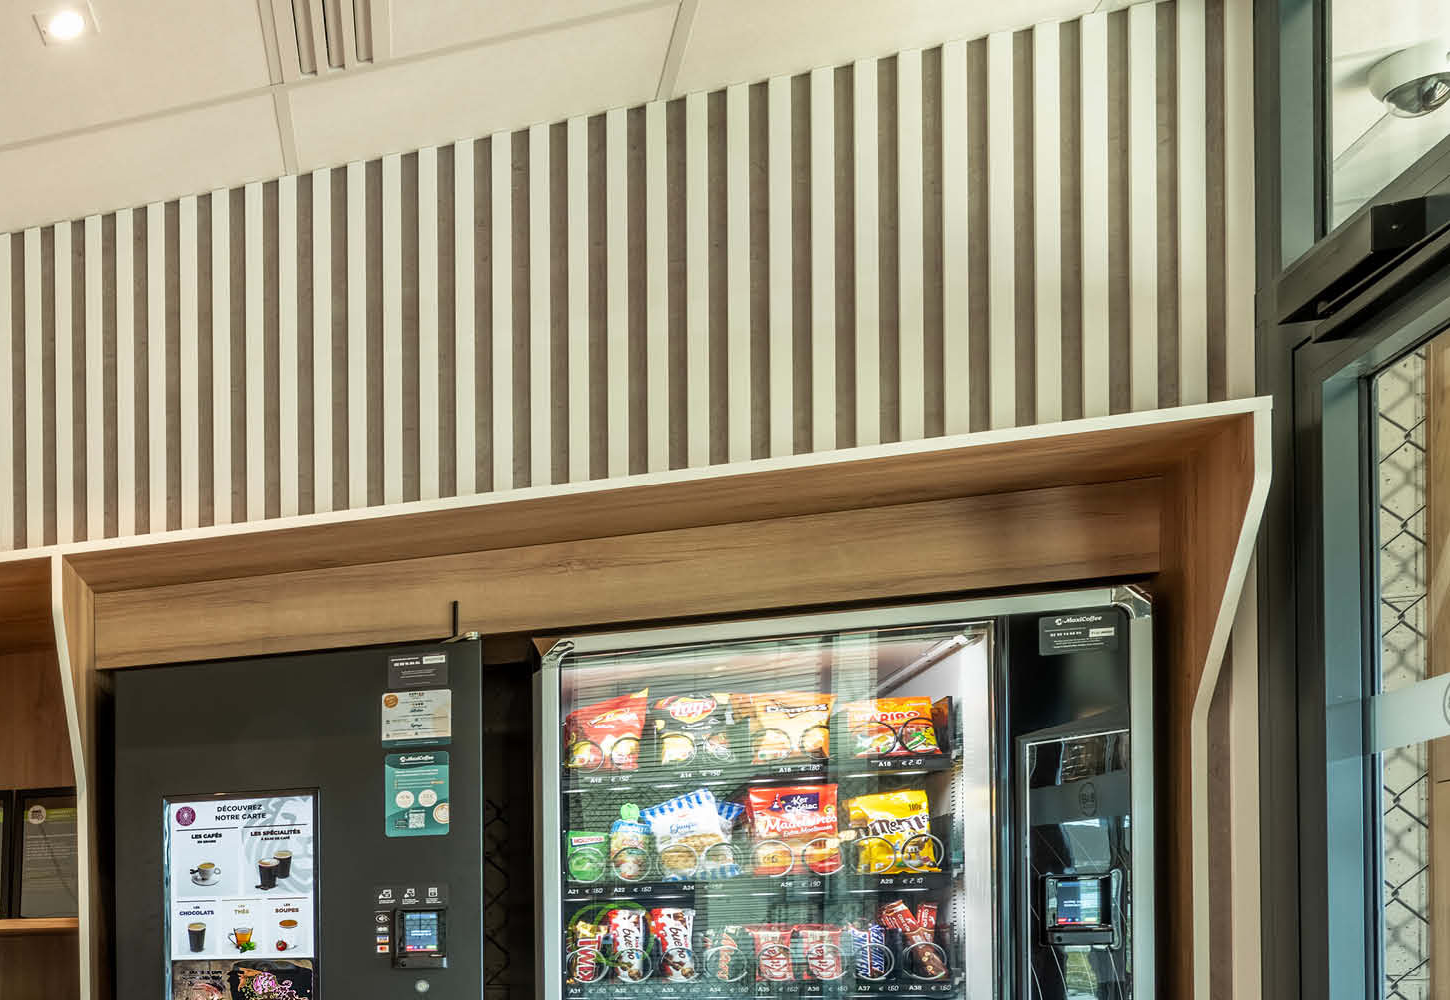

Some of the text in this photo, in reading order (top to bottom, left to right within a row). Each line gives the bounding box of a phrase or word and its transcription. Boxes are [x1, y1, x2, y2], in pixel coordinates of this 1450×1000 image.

[217, 804, 262, 812] DÉCOUVREZ
[241, 812, 266, 820] CARTE
[576, 935, 601, 982] TWIX
[622, 928, 635, 960] bueno
[669, 927, 686, 959] bueno
